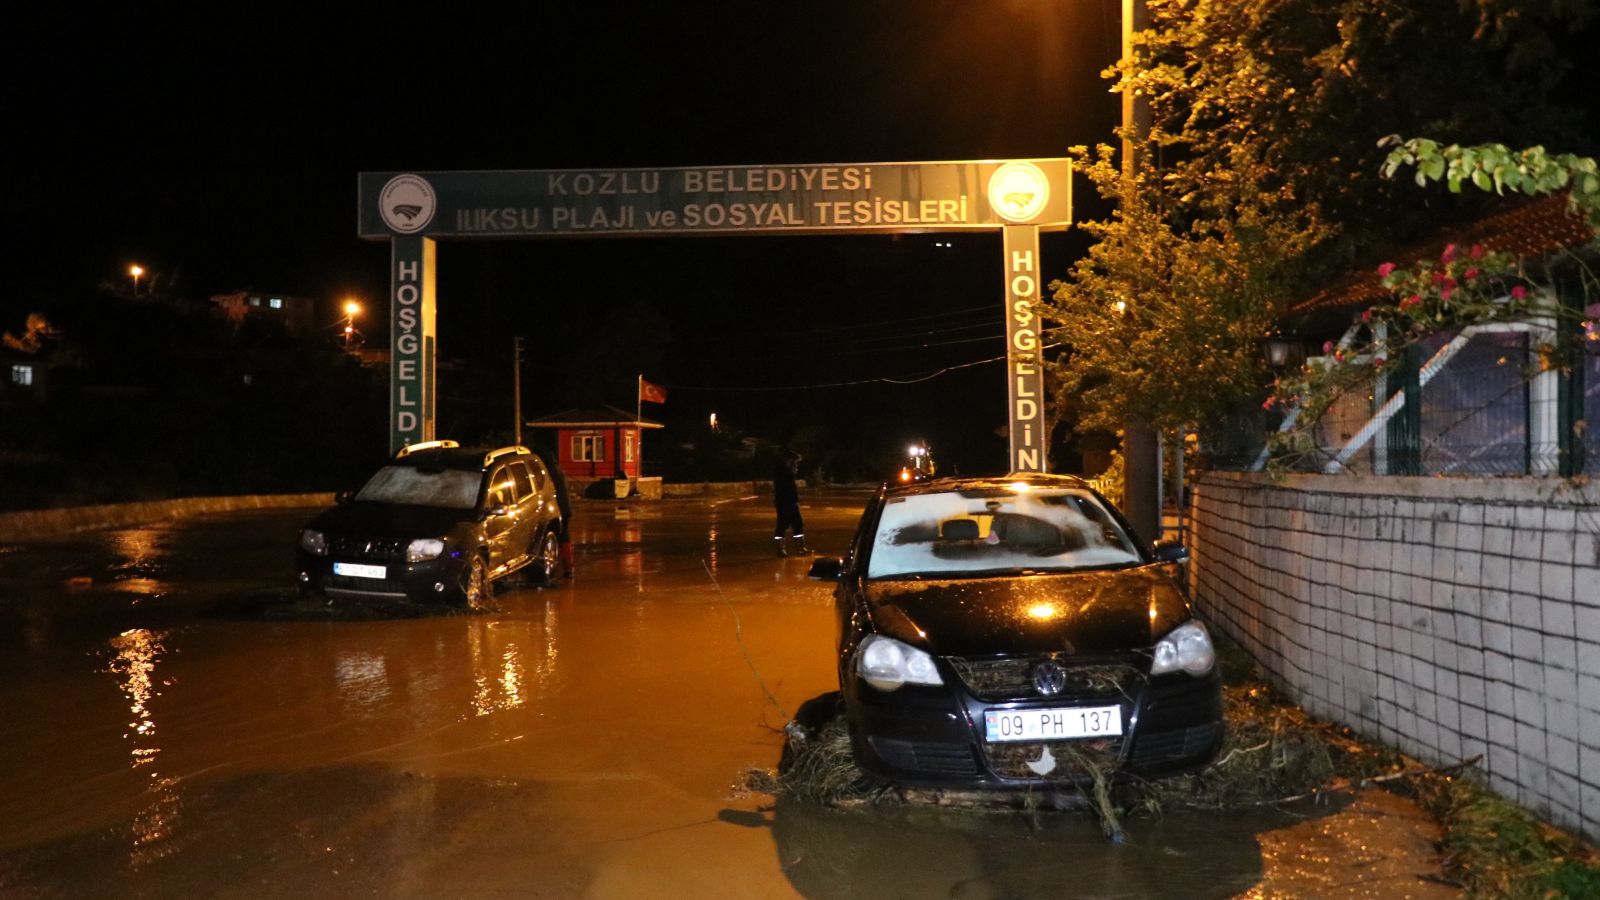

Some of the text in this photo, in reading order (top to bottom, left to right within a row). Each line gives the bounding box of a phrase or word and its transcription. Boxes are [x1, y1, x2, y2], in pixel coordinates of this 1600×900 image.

[548, 172, 660, 195] KOZLU
[552, 205, 635, 229] PLAJI
[645, 209, 676, 228] ve
[683, 202, 804, 226] SOSYAL
[1001, 711, 1112, 736] 09 PH 137
